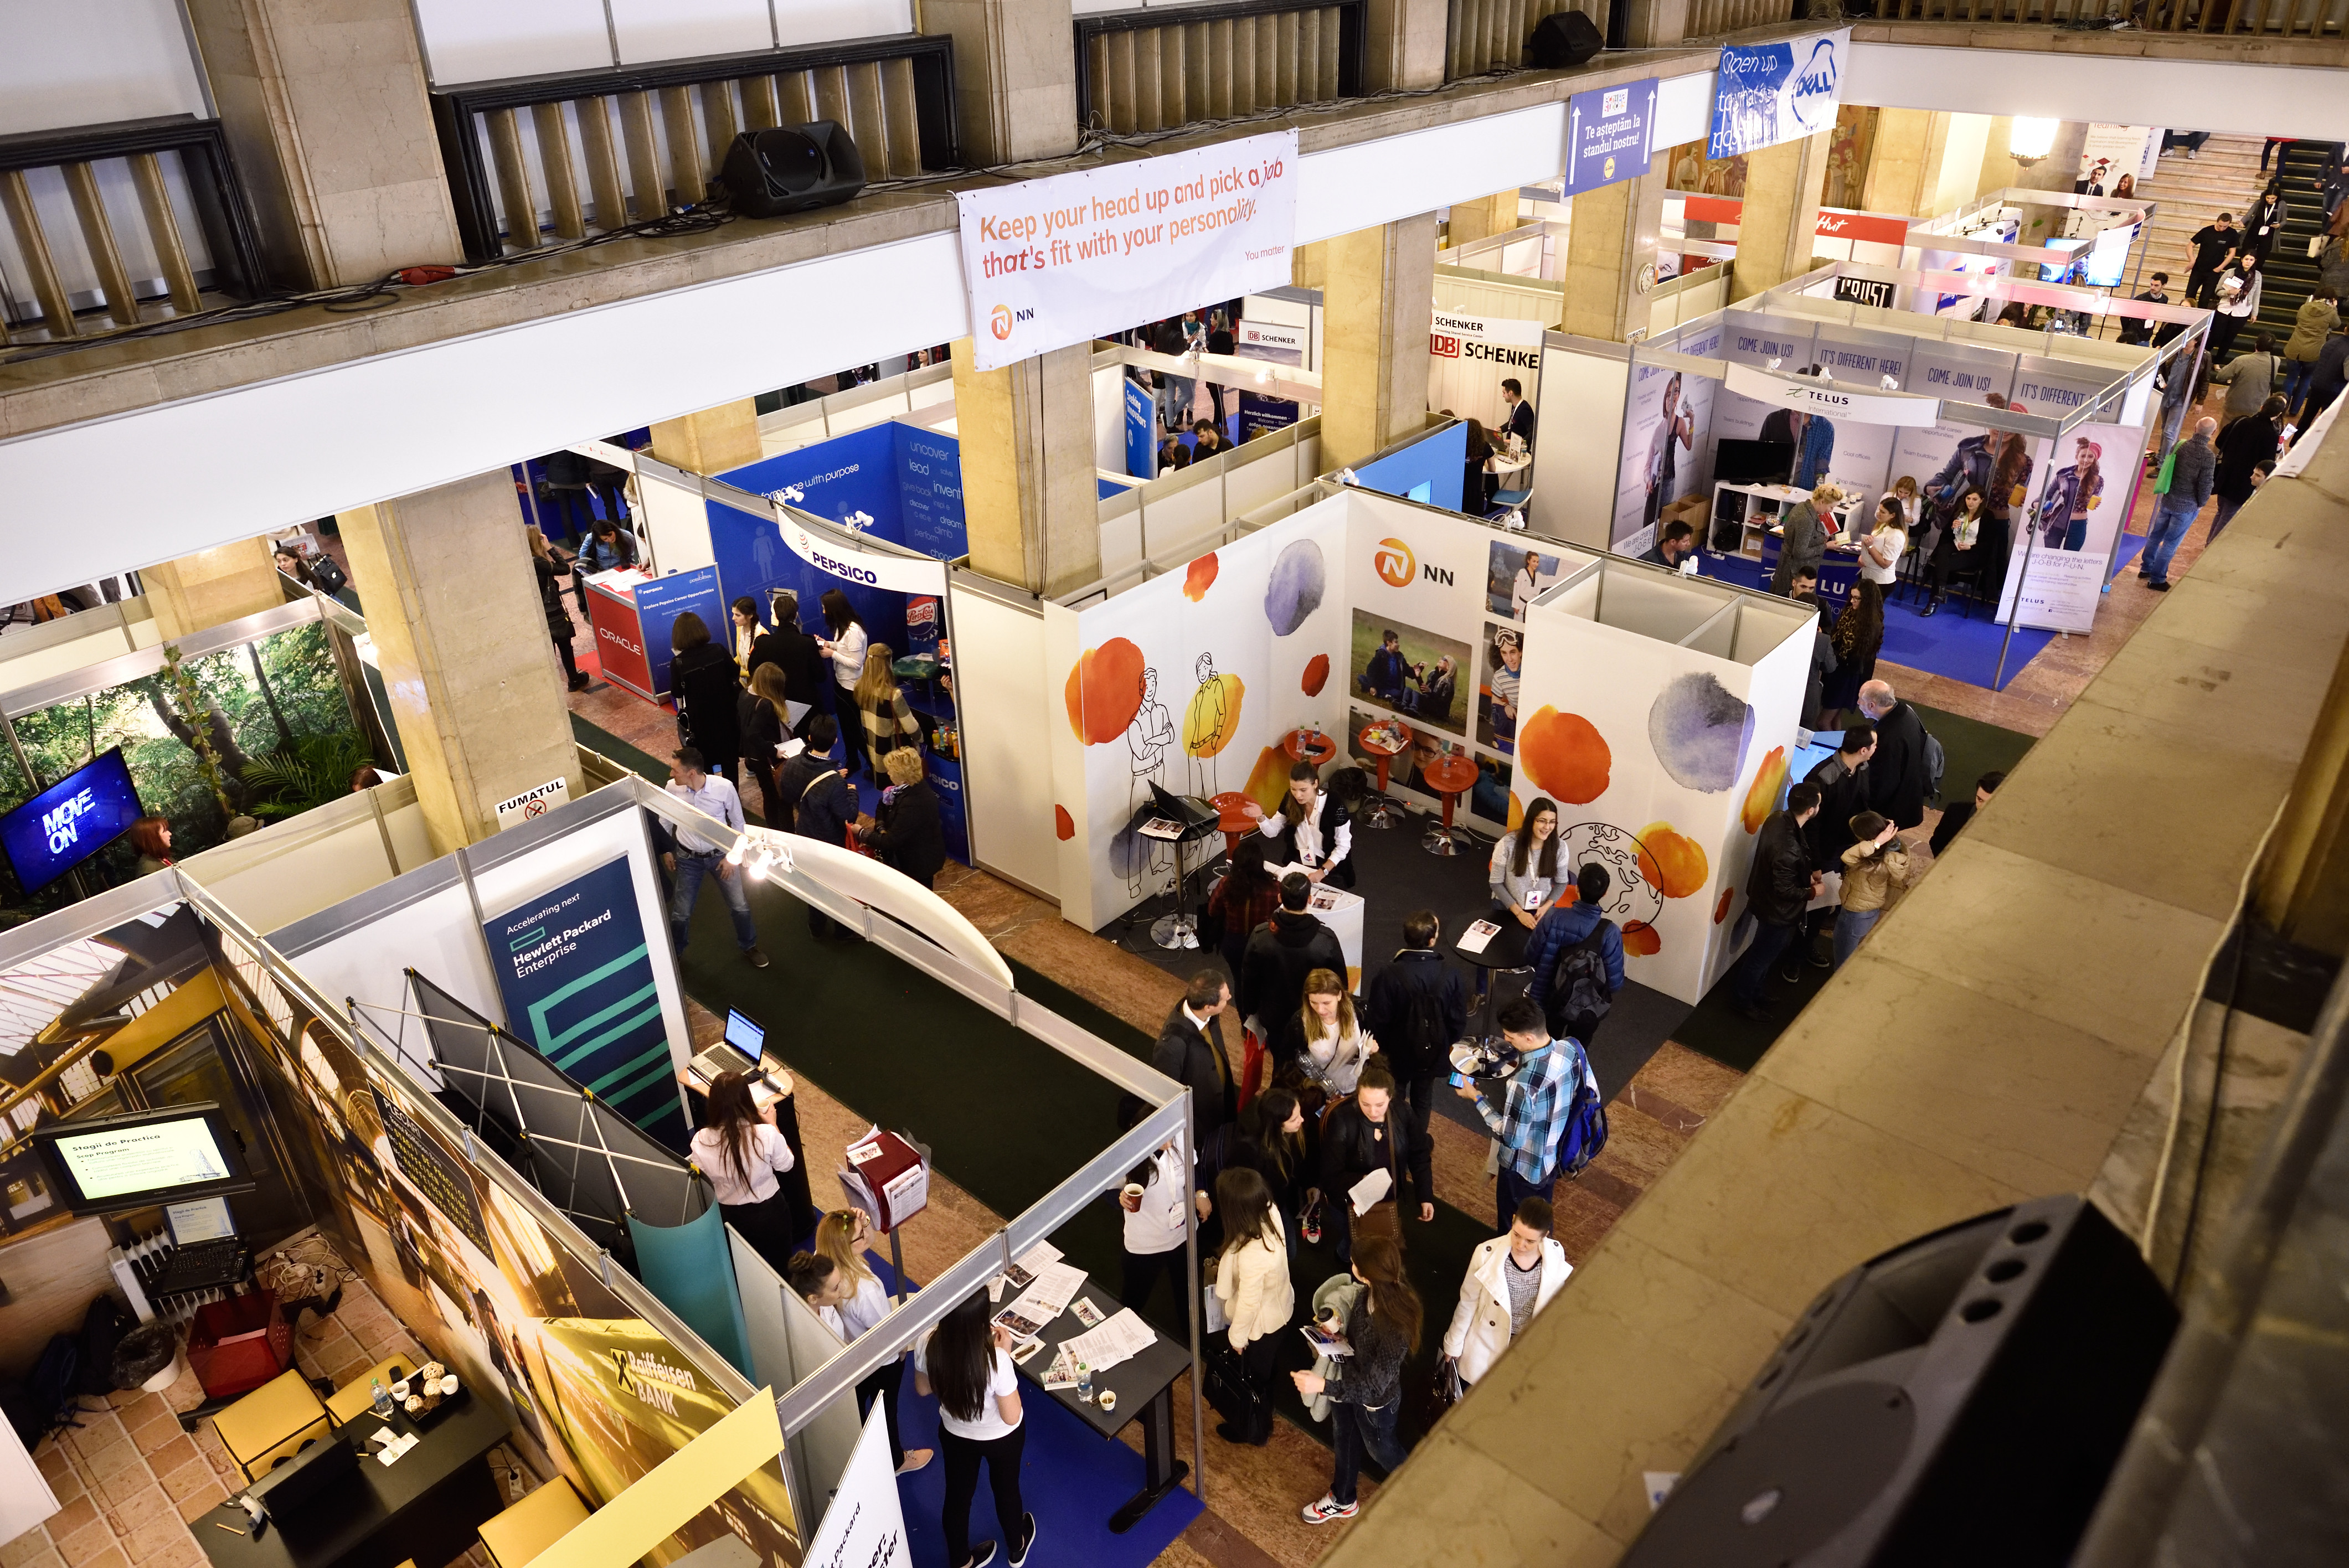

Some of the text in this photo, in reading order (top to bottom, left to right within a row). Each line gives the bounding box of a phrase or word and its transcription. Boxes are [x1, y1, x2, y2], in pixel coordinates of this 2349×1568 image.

[1723, 51, 1778, 79] Open up
[1796, 72, 1831, 97] DELL
[1585, 114, 1640, 141] Te așteptăm la
[1583, 132, 1640, 158] standul nostru!
[981, 156, 1283, 243] Keep your head up and pick a job
[1816, 215, 1848, 232] Hut
[983, 198, 1256, 278] that's fit with your personality.
[1245, 245, 1285, 261] You matter
[1016, 307, 1034, 322] NN
[1435, 317, 1483, 332] SCHENKER
[1262, 335, 1296, 344] SCHENKER
[1627, 329, 1646, 340] FUMATUL
[1709, 334, 1719, 350] HERE!
[1434, 334, 1539, 369] DB SCHENKE
[1738, 337, 1794, 358] COME JOIN US!
[1820, 349, 1903, 375] IT'S DIFFERENT HERE!
[1928, 368, 1991, 391] COME JOIN US!
[1127, 390, 1141, 413] Seeking
[1809, 391, 1848, 405] TELUS
[2020, 383, 2038, 399] IT'S
[2039, 386, 2085, 407] DIFFERENT
[1127, 401, 1146, 429] innovators
[1735, 418, 1754, 427] buildings
[1922, 429, 1954, 439] opportunities
[910, 441, 949, 461] uncover
[1917, 452, 1938, 461] buildings
[805, 463, 859, 487] with purpose
[909, 458, 929, 475] lead
[933, 480, 961, 499] invent
[1850, 480, 1872, 489] discounts
[909, 499, 929, 510] discover
[934, 526, 952, 539] climb
[940, 515, 962, 530] dream
[914, 528, 939, 544] perform
[1624, 540, 1631, 549] We
[1640, 528, 1653, 539] chang
[1634, 541, 1647, 553] J-O-B
[812, 551, 877, 584] PEPSICO
[2041, 553, 2070, 563] changing
[1424, 564, 1454, 587] NN
[643, 586, 663, 595] PEPSICO
[688, 588, 714, 599] Opportunities
[600, 627, 641, 656] ORACLE
[929, 774, 959, 790] SICO
[499, 781, 563, 813] FUMATUL
[42, 787, 95, 836] MOVE
[50, 821, 78, 854] ON
[507, 893, 580, 935] Accelerating next
[513, 909, 611, 967] Hewlett Packard
[517, 942, 576, 978] Enterprise
[73, 1143, 102, 1152] Stagii
[96, 1148, 129, 1157] Program
[627, 1351, 696, 1391] Raiffeisen
[637, 1380, 679, 1417] BANK
[834, 1502, 861, 1562] Packard
